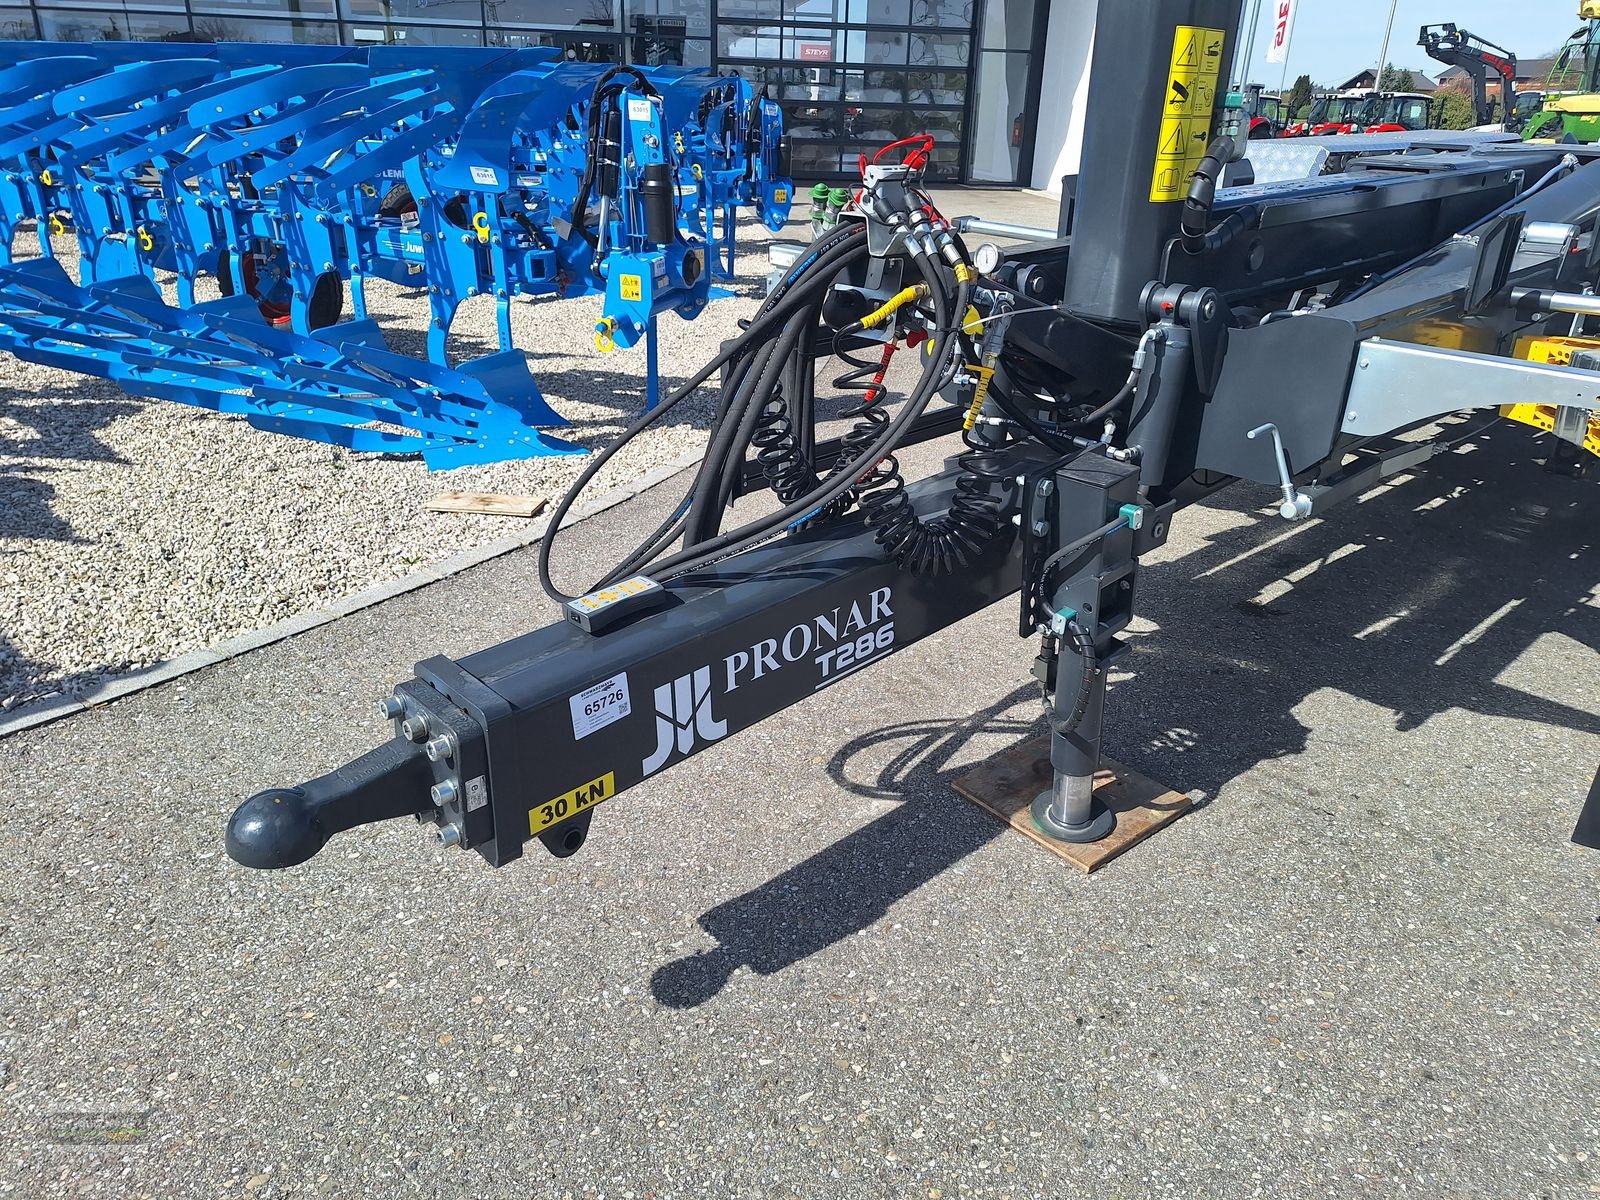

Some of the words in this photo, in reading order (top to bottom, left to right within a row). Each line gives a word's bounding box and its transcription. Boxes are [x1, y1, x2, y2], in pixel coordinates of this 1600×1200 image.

[805, 48, 829, 56] STEYR
[722, 586, 895, 694] PRONAR
[814, 621, 895, 677] T286
[584, 688, 624, 716] 65726
[540, 798, 568, 825] 30
[575, 779, 605, 809] kN
